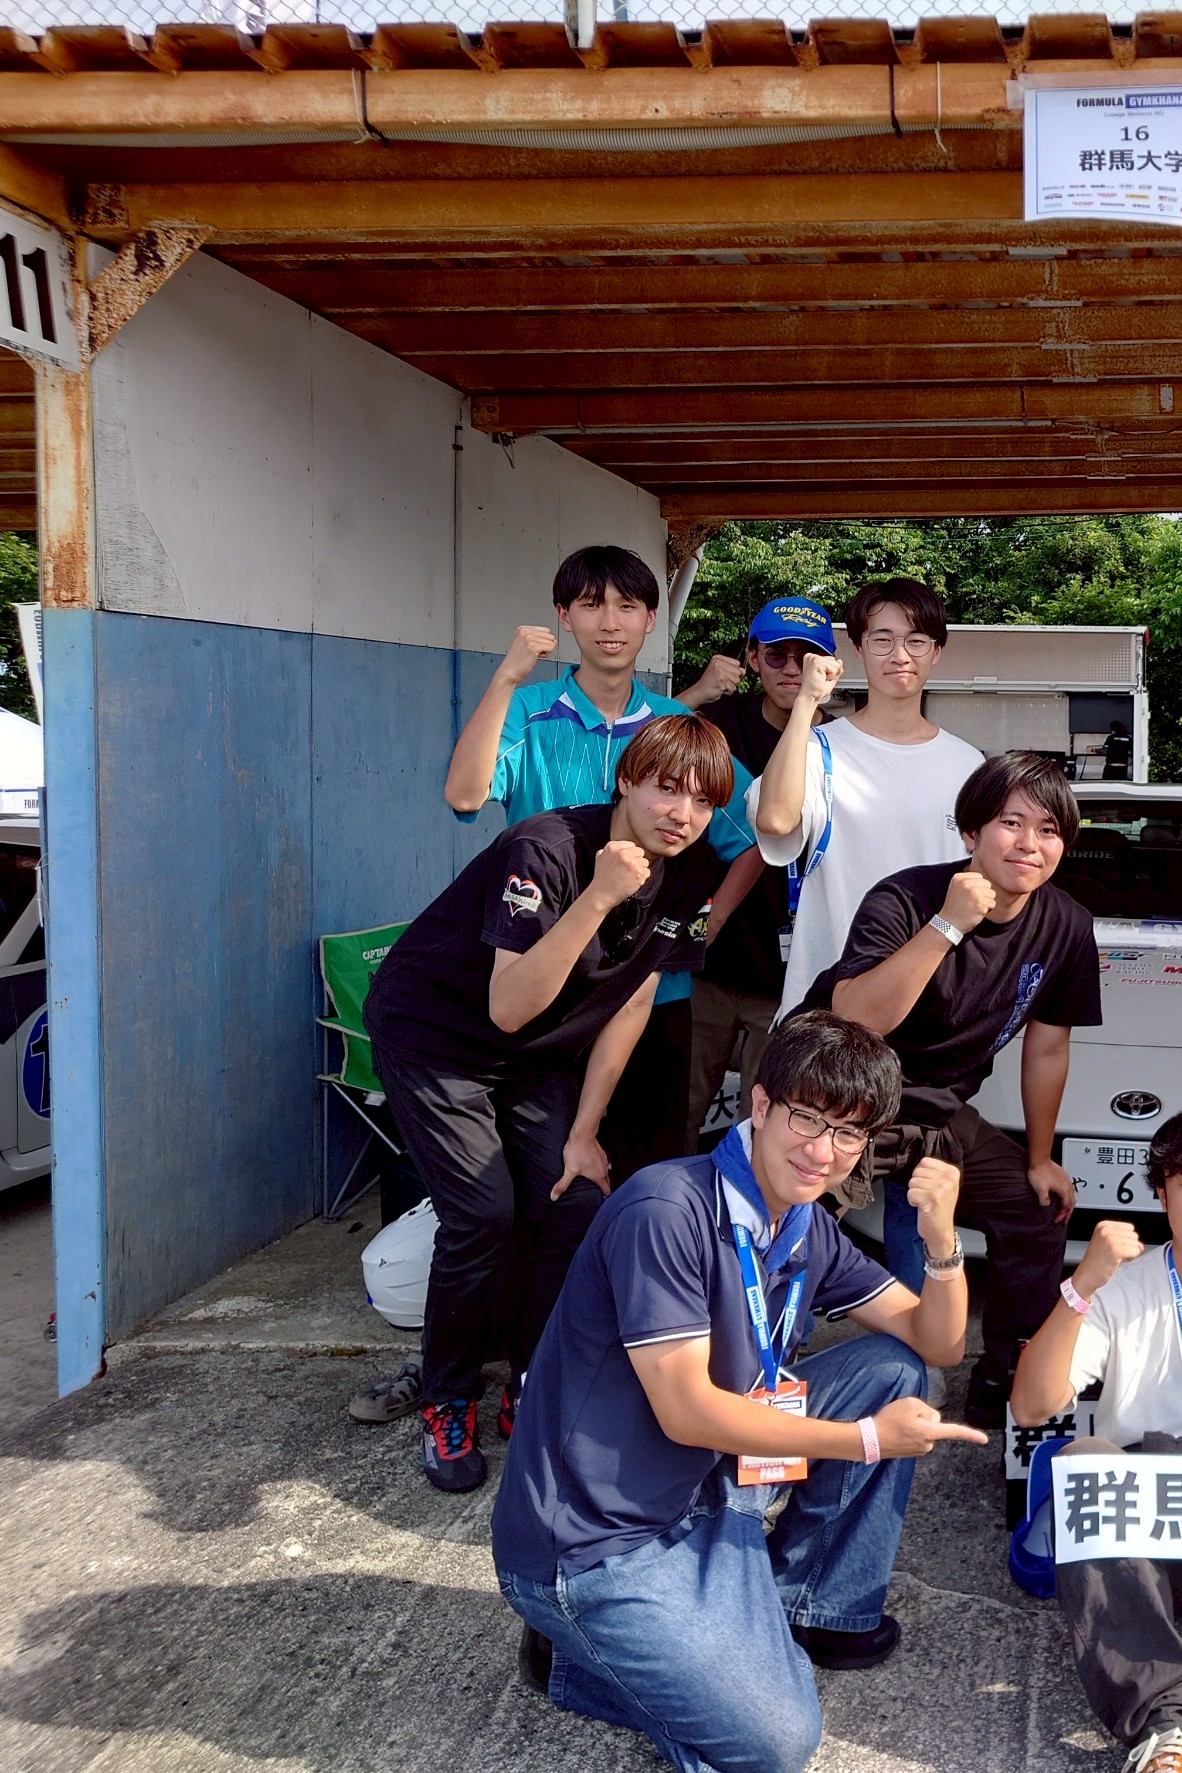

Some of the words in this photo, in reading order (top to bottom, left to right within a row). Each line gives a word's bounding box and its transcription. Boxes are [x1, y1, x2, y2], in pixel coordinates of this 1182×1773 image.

[1076, 97, 1124, 107] FORMULA
[1120, 126, 1150, 142] 16
[0, 232, 58, 345] 11
[773, 606, 827, 625] GOODYEAR
[1066, 851, 1115, 860] BRIDE
[710, 1088, 741, 1124] 大
[757, 1322, 770, 1350] FORMULA
[760, 1466, 785, 1480] PASS
